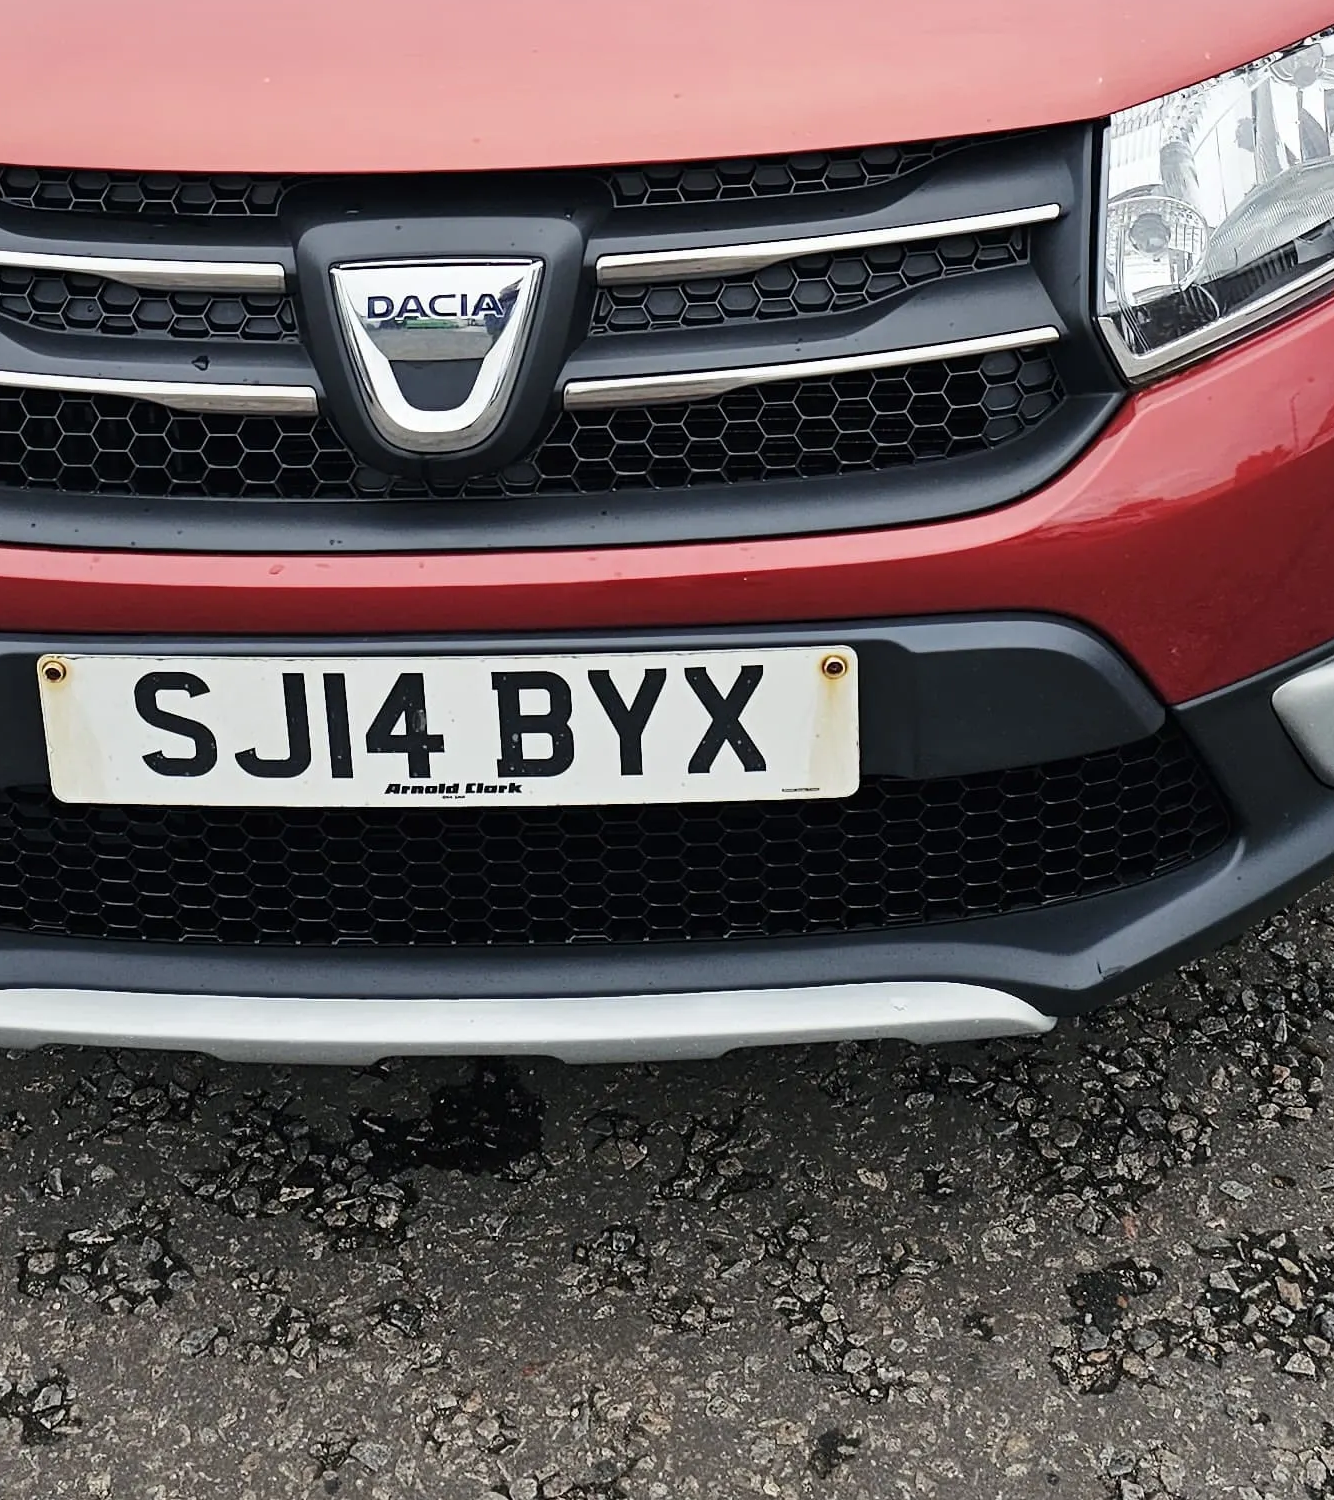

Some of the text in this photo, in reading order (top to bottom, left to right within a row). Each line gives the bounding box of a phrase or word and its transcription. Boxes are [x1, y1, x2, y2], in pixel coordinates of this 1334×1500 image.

[366, 293, 504, 320] DACIA
[133, 665, 767, 779] SJ14 BYX
[384, 782, 523, 795] Arnold Clark
